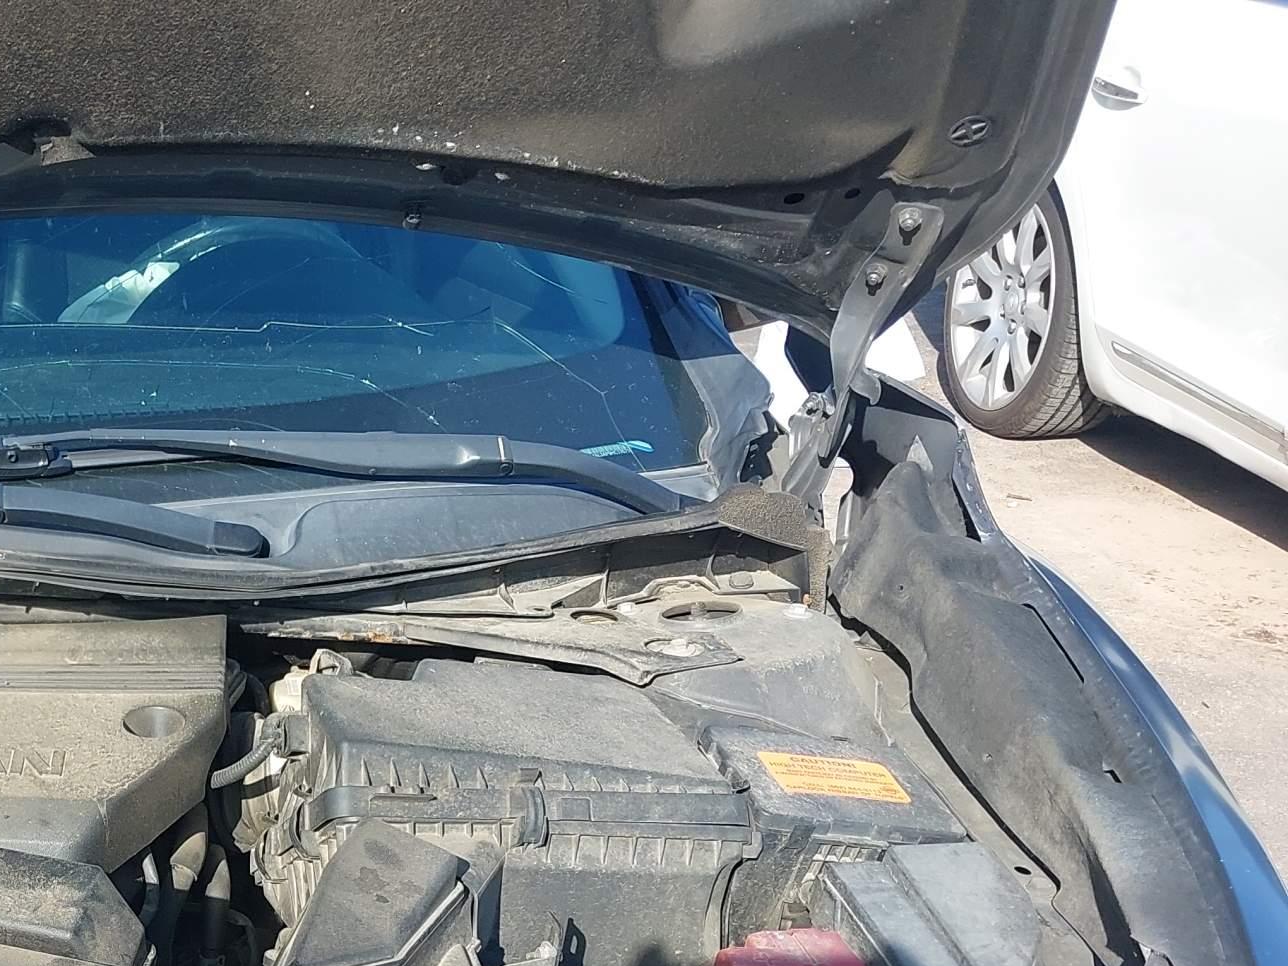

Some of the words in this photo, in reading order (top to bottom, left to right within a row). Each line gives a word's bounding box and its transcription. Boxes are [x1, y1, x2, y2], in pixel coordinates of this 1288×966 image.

[789, 756, 857, 769] CAUTION!
[797, 764, 826, 772] TECH
[827, 766, 887, 778] COMPUTER
